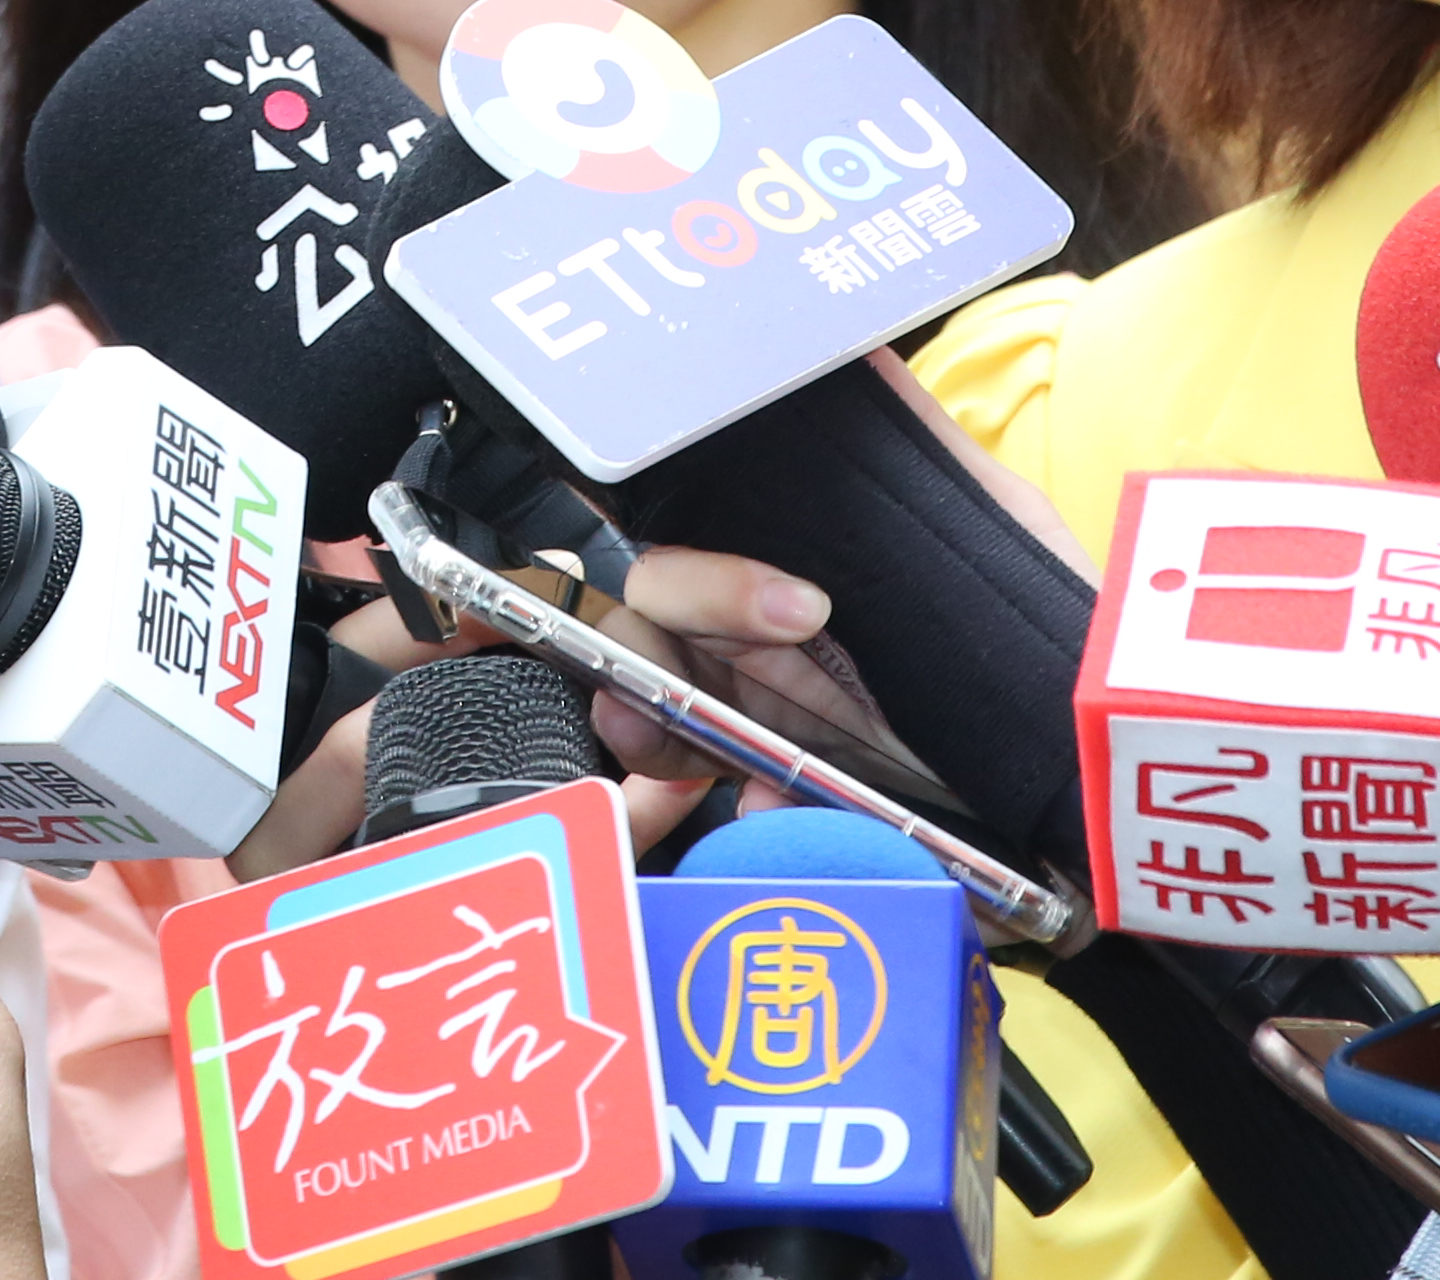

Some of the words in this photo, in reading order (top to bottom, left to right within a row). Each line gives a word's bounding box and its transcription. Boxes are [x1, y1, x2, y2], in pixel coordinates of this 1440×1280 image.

[254, 117, 428, 348] 公
[490, 97, 968, 361] ETtoday
[798, 183, 982, 295] 新聞雲
[137, 403, 228, 696] 壹新聞
[1136, 747, 1276, 924] 非凡
[191, 905, 567, 1174] 放言
[706, 916, 848, 1086] 唐
[293, 1136, 415, 1204] FOUNT
[422, 1104, 533, 1164] MEDIA
[668, 1105, 911, 1185] NTD
